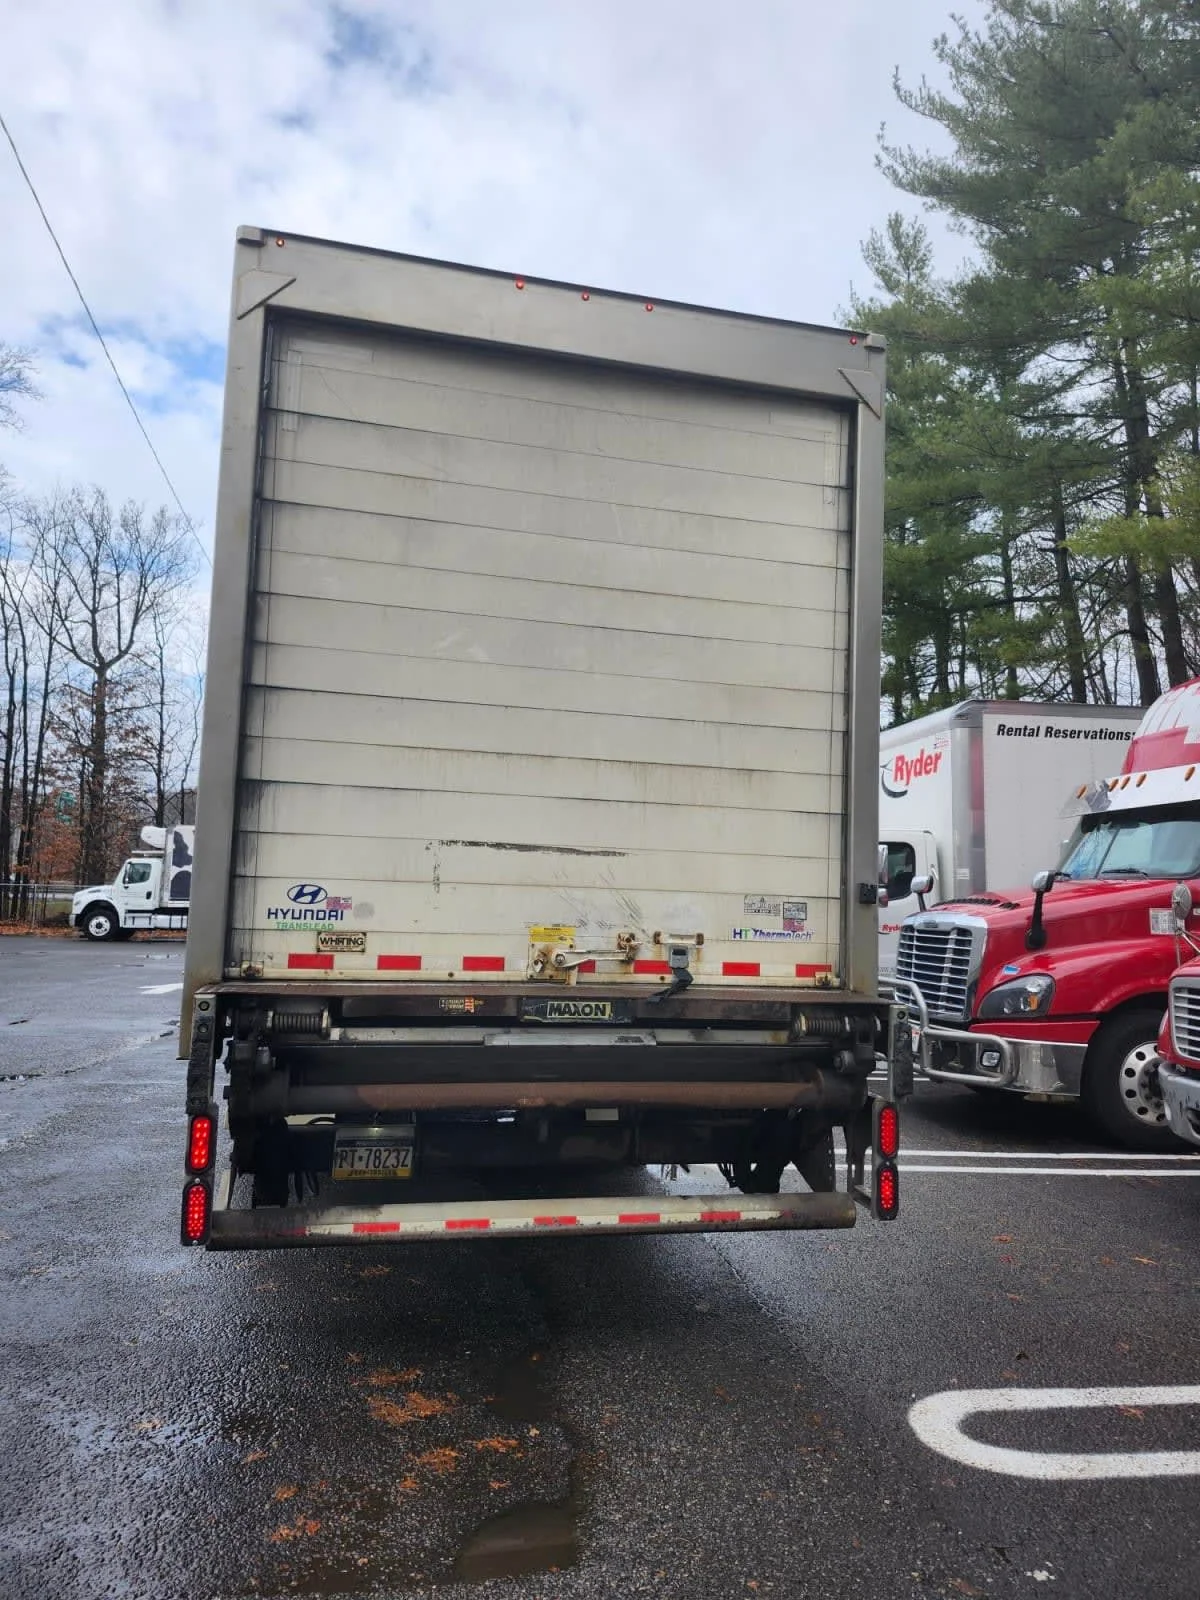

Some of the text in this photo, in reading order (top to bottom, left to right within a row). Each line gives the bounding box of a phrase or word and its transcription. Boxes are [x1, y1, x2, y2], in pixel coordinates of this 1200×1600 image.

[996, 723, 1041, 738] Rental
[893, 747, 942, 786] Ryder
[267, 907, 344, 921] HYUNDAI
[275, 922, 335, 931] TRANSLEAD
[733, 928, 750, 939] HT
[319, 935, 365, 946] WHITING
[547, 1002, 607, 1017] MAXON
